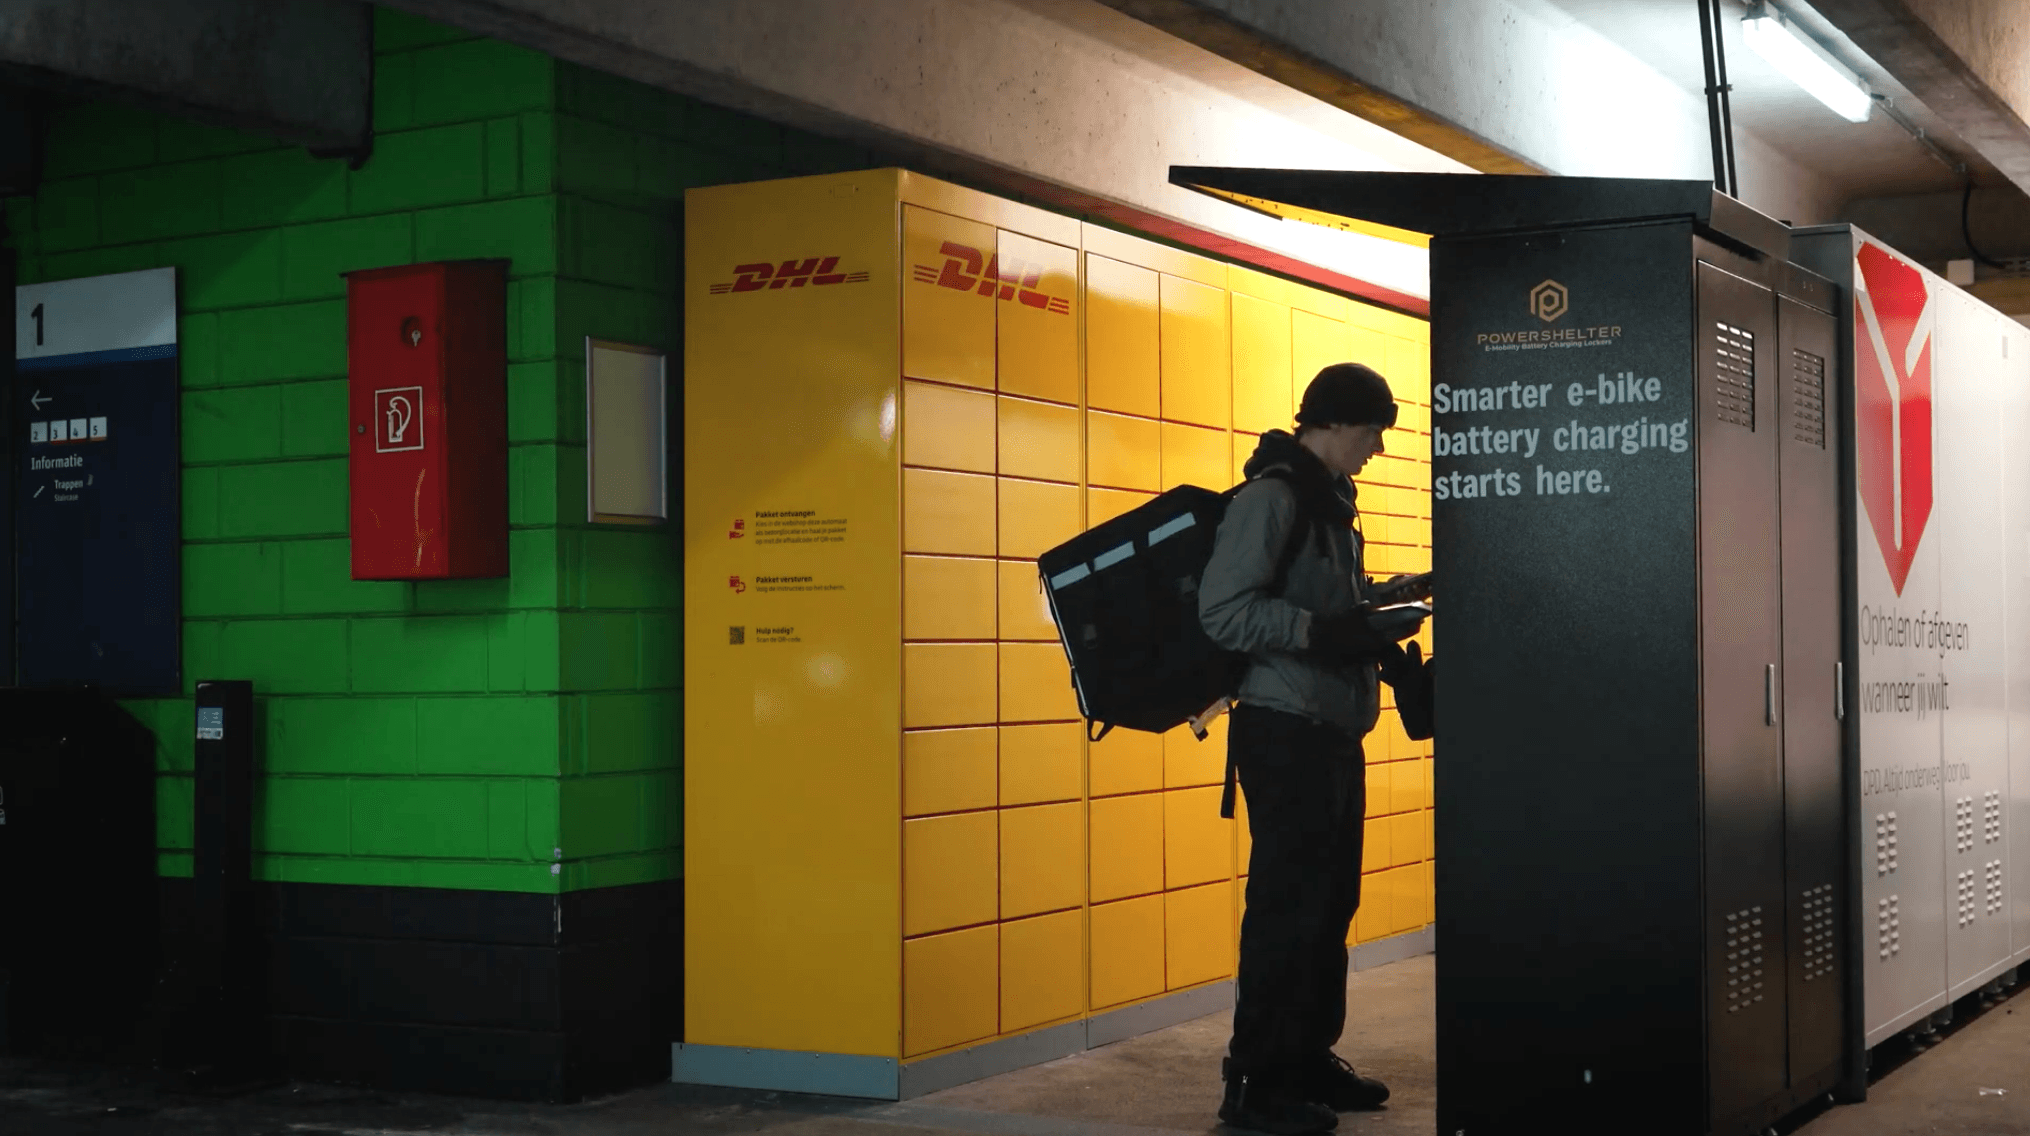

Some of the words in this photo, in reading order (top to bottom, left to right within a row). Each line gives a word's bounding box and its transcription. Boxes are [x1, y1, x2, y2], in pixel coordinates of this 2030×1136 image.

[731, 257, 847, 293] DHL
[937, 241, 1050, 309] DHL
[31, 303, 44, 346] 1
[1477, 326, 1622, 345] POWERSHELTER
[1485, 343, 1520, 351] E-Mobility
[1521, 341, 1548, 350] Battery
[1549, 340, 1583, 349] Charging
[1584, 339, 1612, 347] Lockers
[1434, 380, 1552, 414] Smarter
[1567, 371, 1661, 406] e-bike
[1434, 425, 1540, 458] battery
[1553, 417, 1688, 455] charging
[31, 453, 83, 471] Informatie
[54, 479, 84, 491] Trappen
[1435, 468, 1521, 500] starts
[1536, 464, 1610, 495] here.
[779, 510, 816, 518] ontvangen
[756, 627, 771, 635] Hulp
[772, 626, 794, 635] nodig?
[1861, 604, 1911, 656] Ophalen
[1914, 609, 1926, 648] of
[1928, 610, 1969, 659] afgeven
[1861, 682, 1916, 714] wanneer
[1917, 672, 1926, 721] jij
[1927, 672, 1949, 711] wilt
